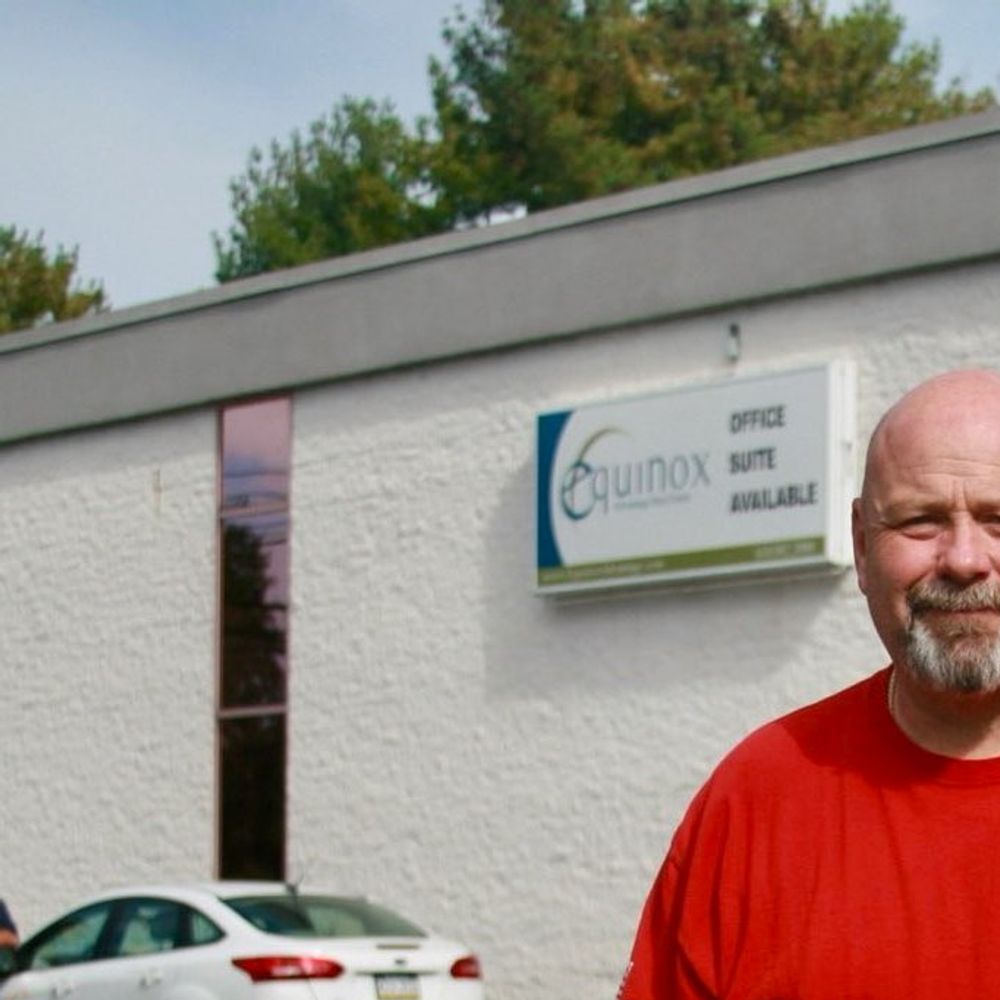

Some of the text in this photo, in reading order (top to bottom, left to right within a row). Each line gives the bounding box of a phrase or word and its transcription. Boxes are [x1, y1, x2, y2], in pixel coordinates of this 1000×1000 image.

[729, 404, 785, 434] OFFICE
[729, 447, 777, 475] SUITE
[729, 481, 818, 514] AVAILABLE
